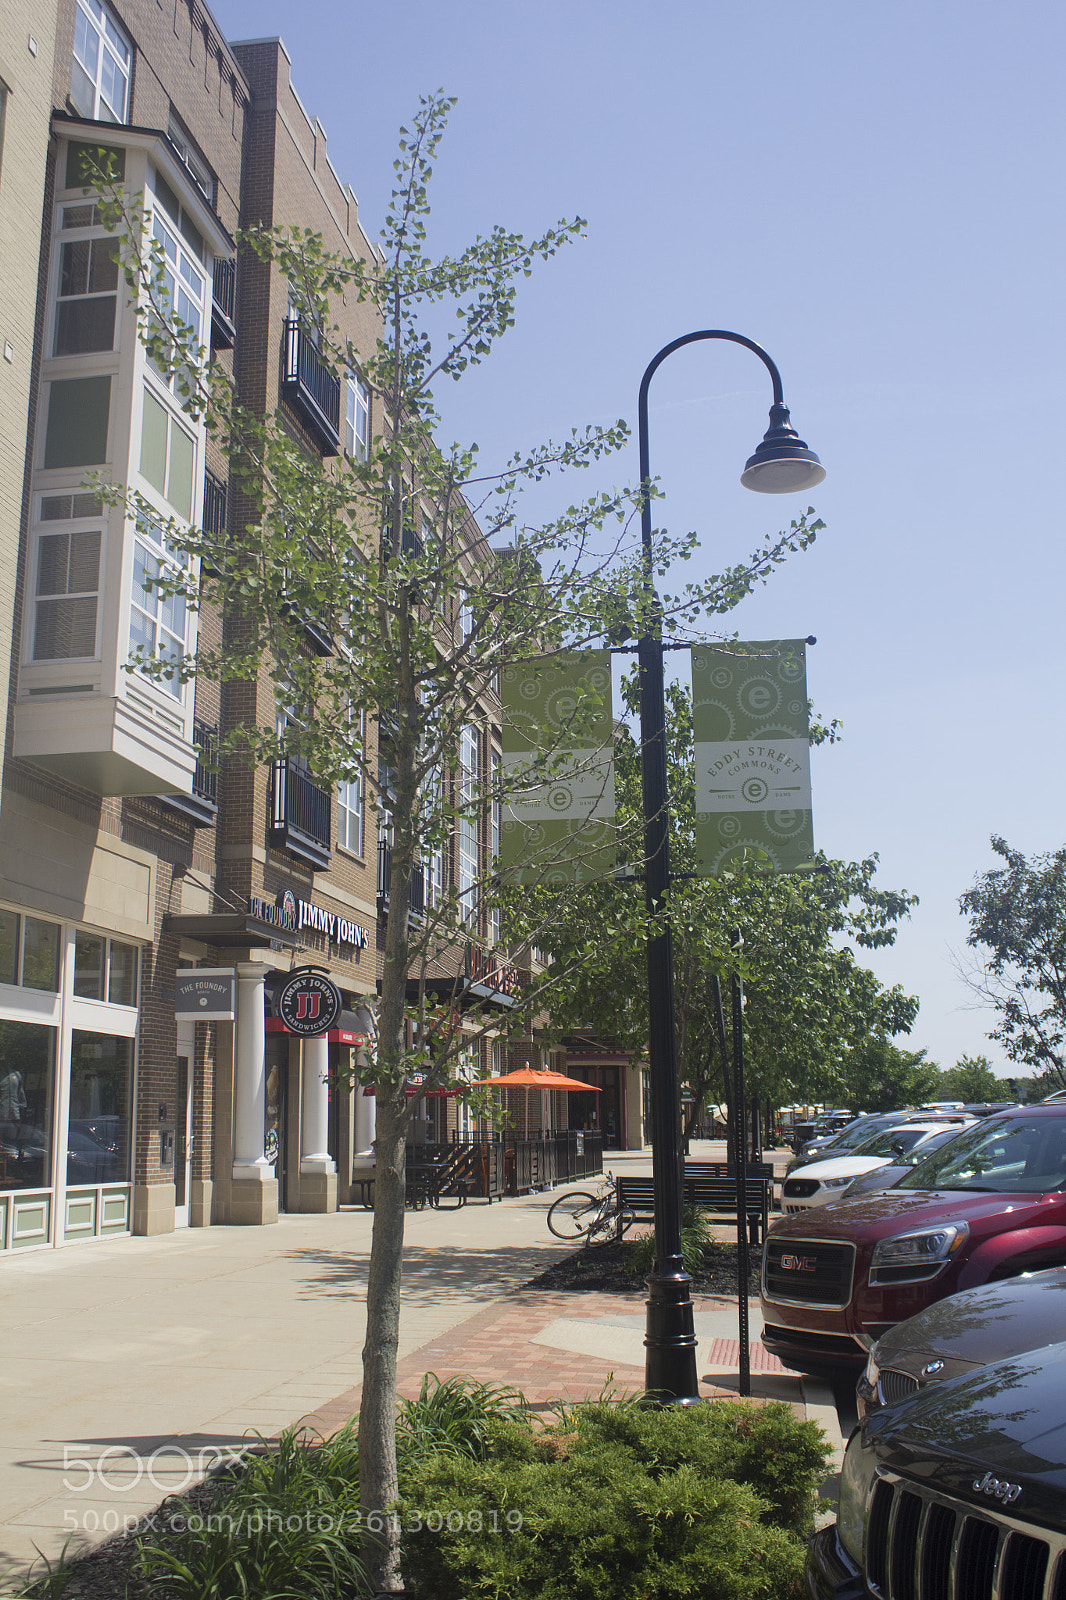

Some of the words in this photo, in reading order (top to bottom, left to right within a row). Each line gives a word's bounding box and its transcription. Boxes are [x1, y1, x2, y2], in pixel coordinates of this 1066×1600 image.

[707, 749, 741, 777] EDDY
[748, 746, 802, 773] STREET
[728, 760, 781, 777] COMMONS
[298, 899, 335, 935] JIMMY
[337, 917, 369, 949] JOHN'S
[180, 983, 194, 995] THE
[195, 981, 228, 994] FOUNDRY
[283, 979, 307, 1006] JIMMY
[309, 979, 334, 1005] JOHN'S
[780, 1254, 817, 1272] GMC
[972, 1471, 1023, 1505] Jeep
